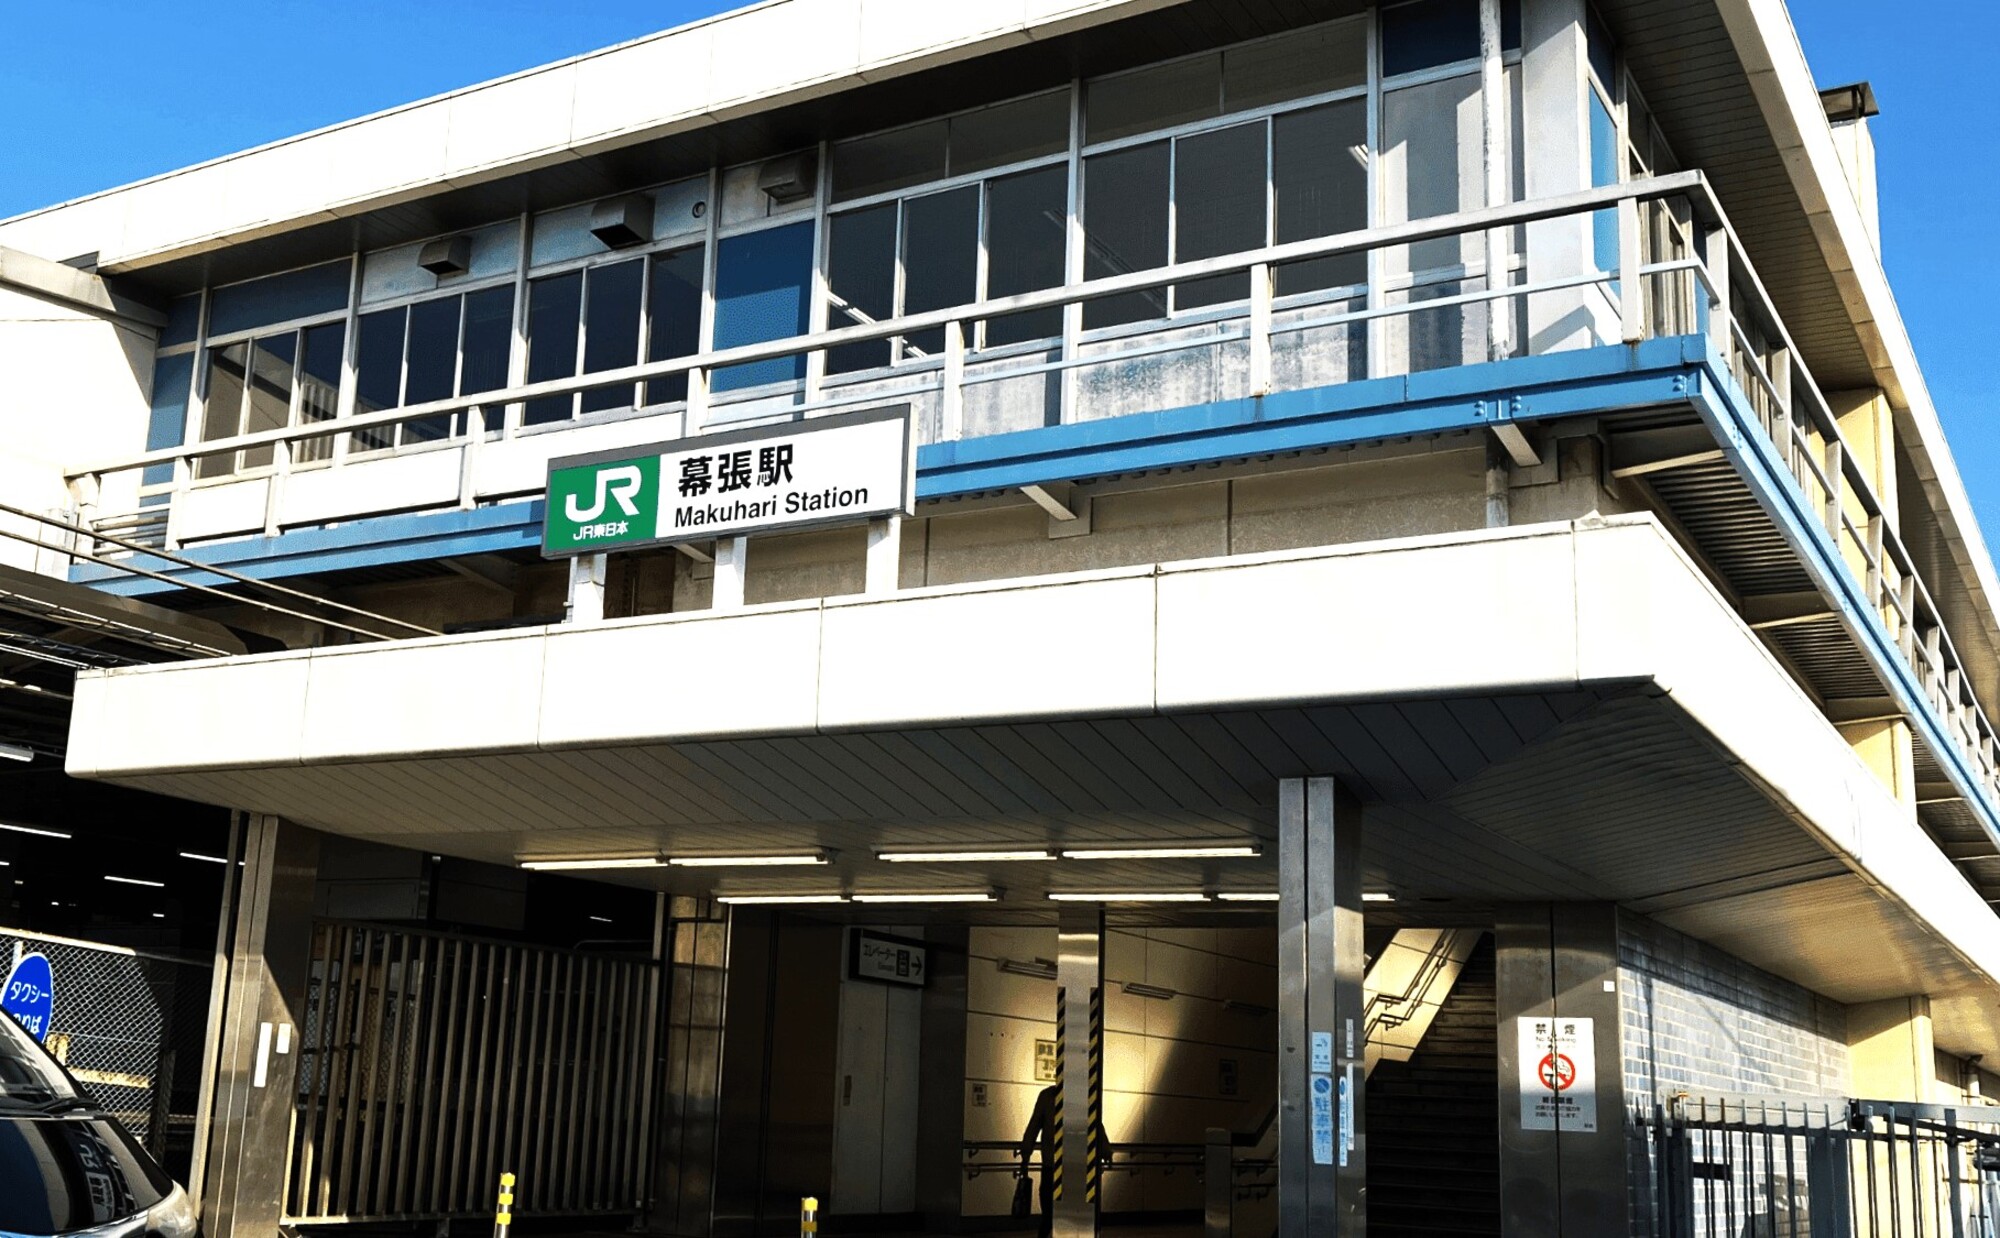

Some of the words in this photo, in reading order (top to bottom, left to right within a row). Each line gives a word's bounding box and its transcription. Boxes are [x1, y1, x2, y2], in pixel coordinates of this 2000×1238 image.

[678, 444, 793, 497] 幕張駅
[565, 465, 642, 522] JR
[675, 495, 777, 528] Makuhari
[785, 486, 868, 514] Station
[573, 520, 629, 540] JR東日本
[10, 981, 49, 1004] タクシー
